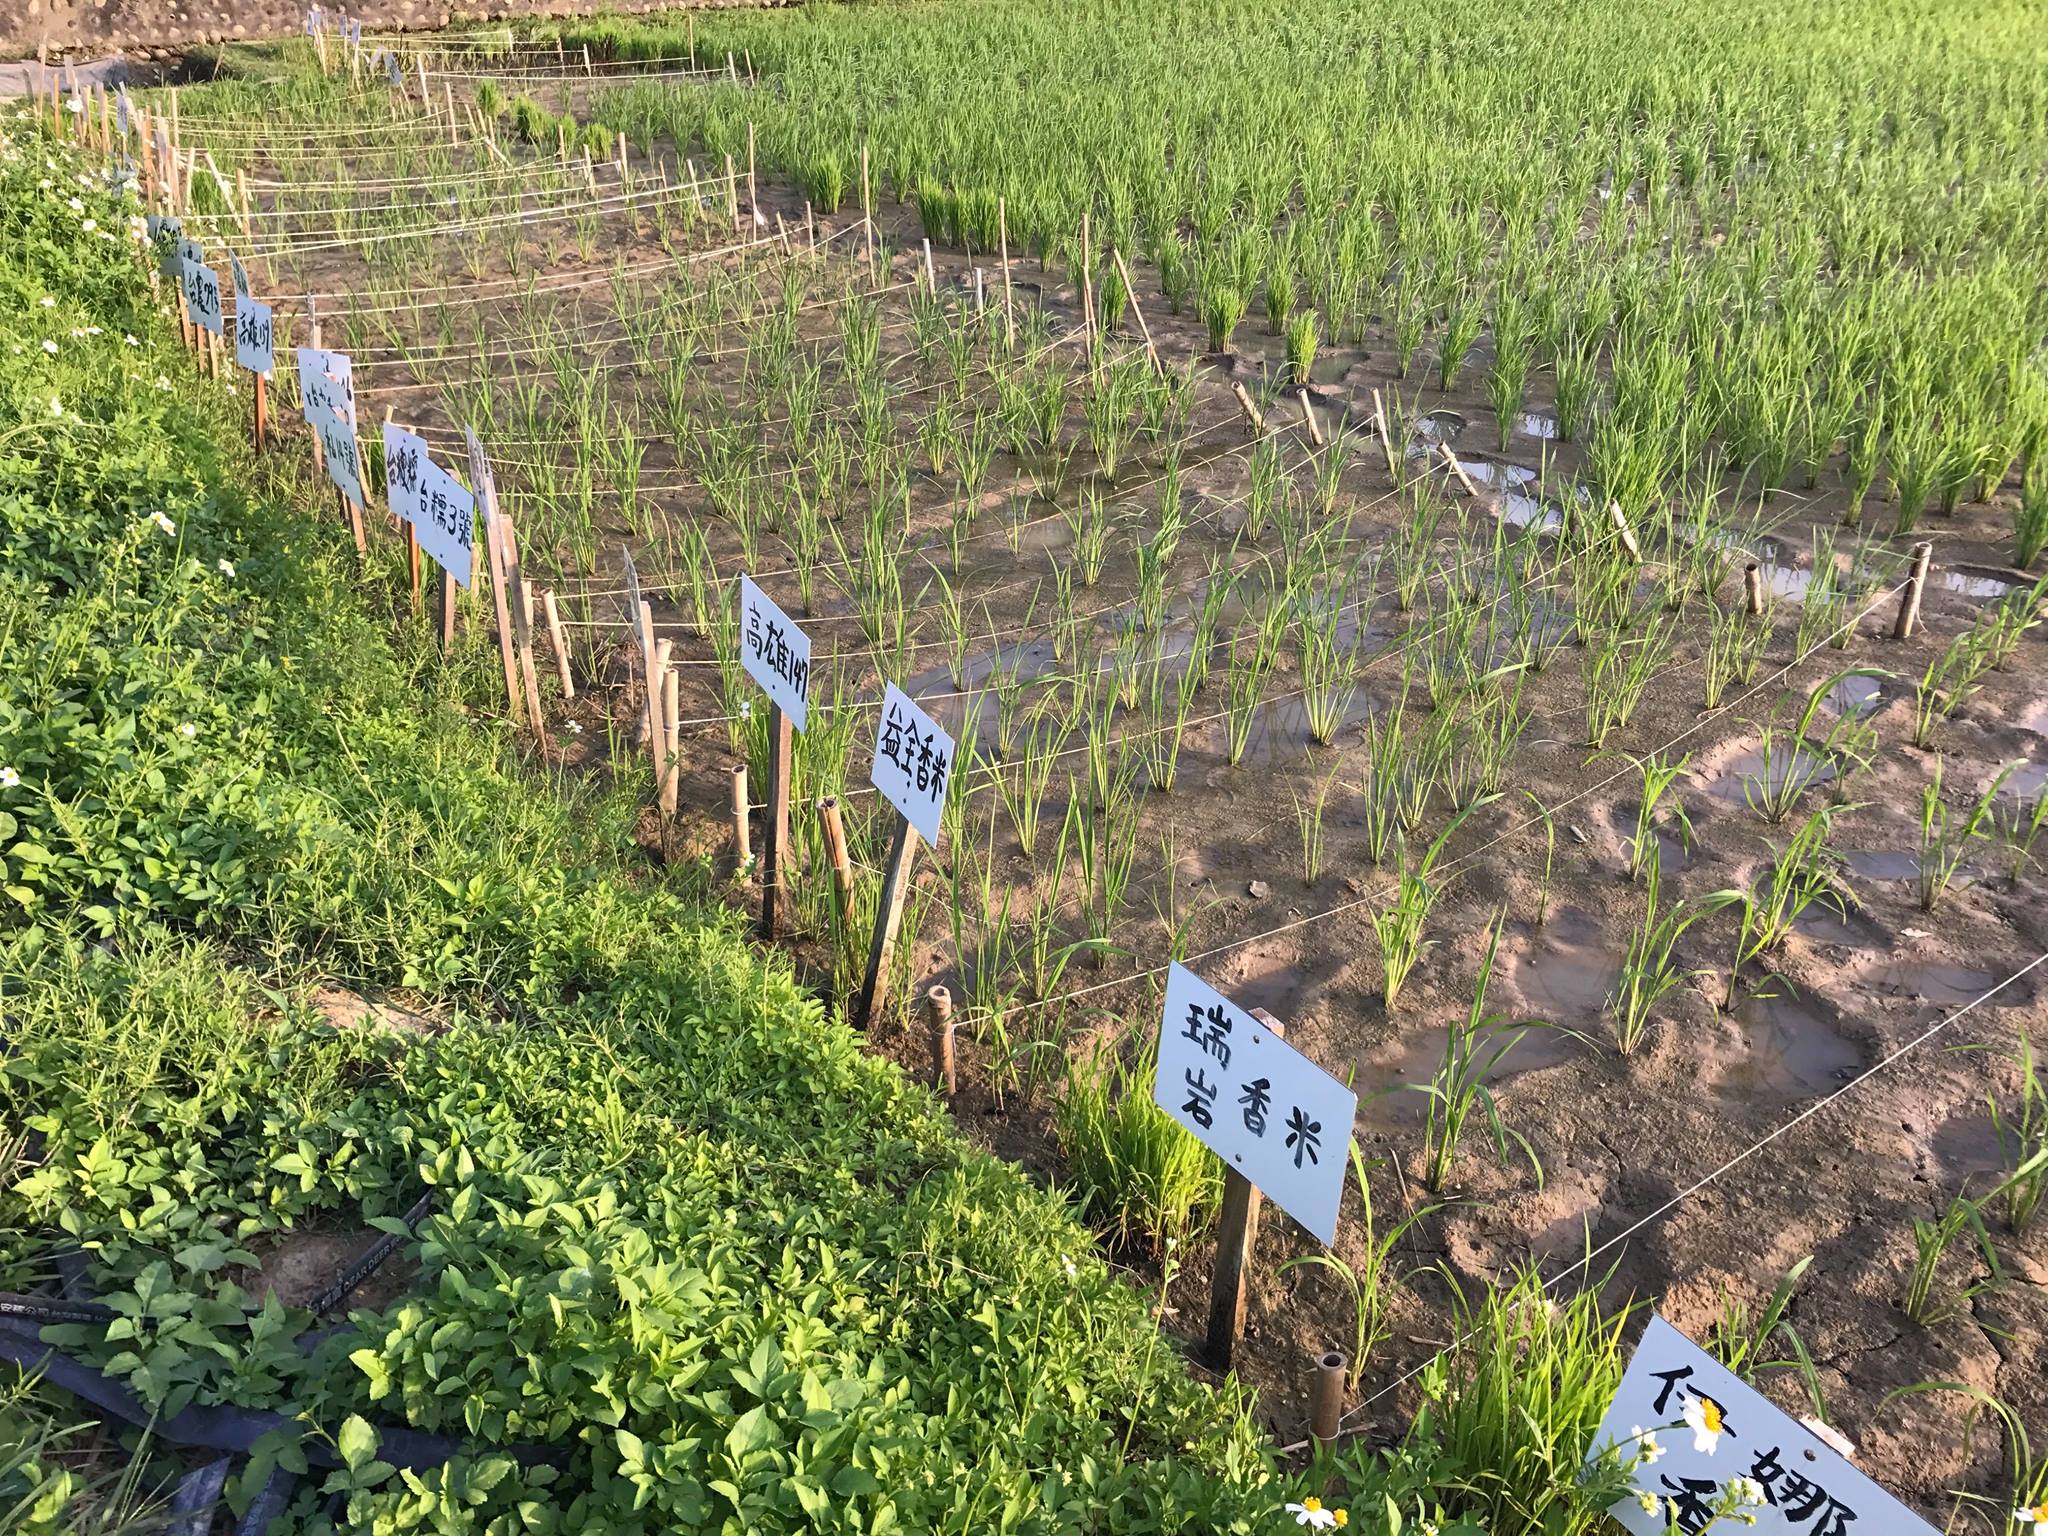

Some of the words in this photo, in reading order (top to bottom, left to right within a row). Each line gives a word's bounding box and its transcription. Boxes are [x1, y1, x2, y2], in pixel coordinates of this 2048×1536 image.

[420, 478, 472, 552] 台糯3號
[746, 601, 809, 702] 高雄147
[881, 702, 947, 802] 益全香米
